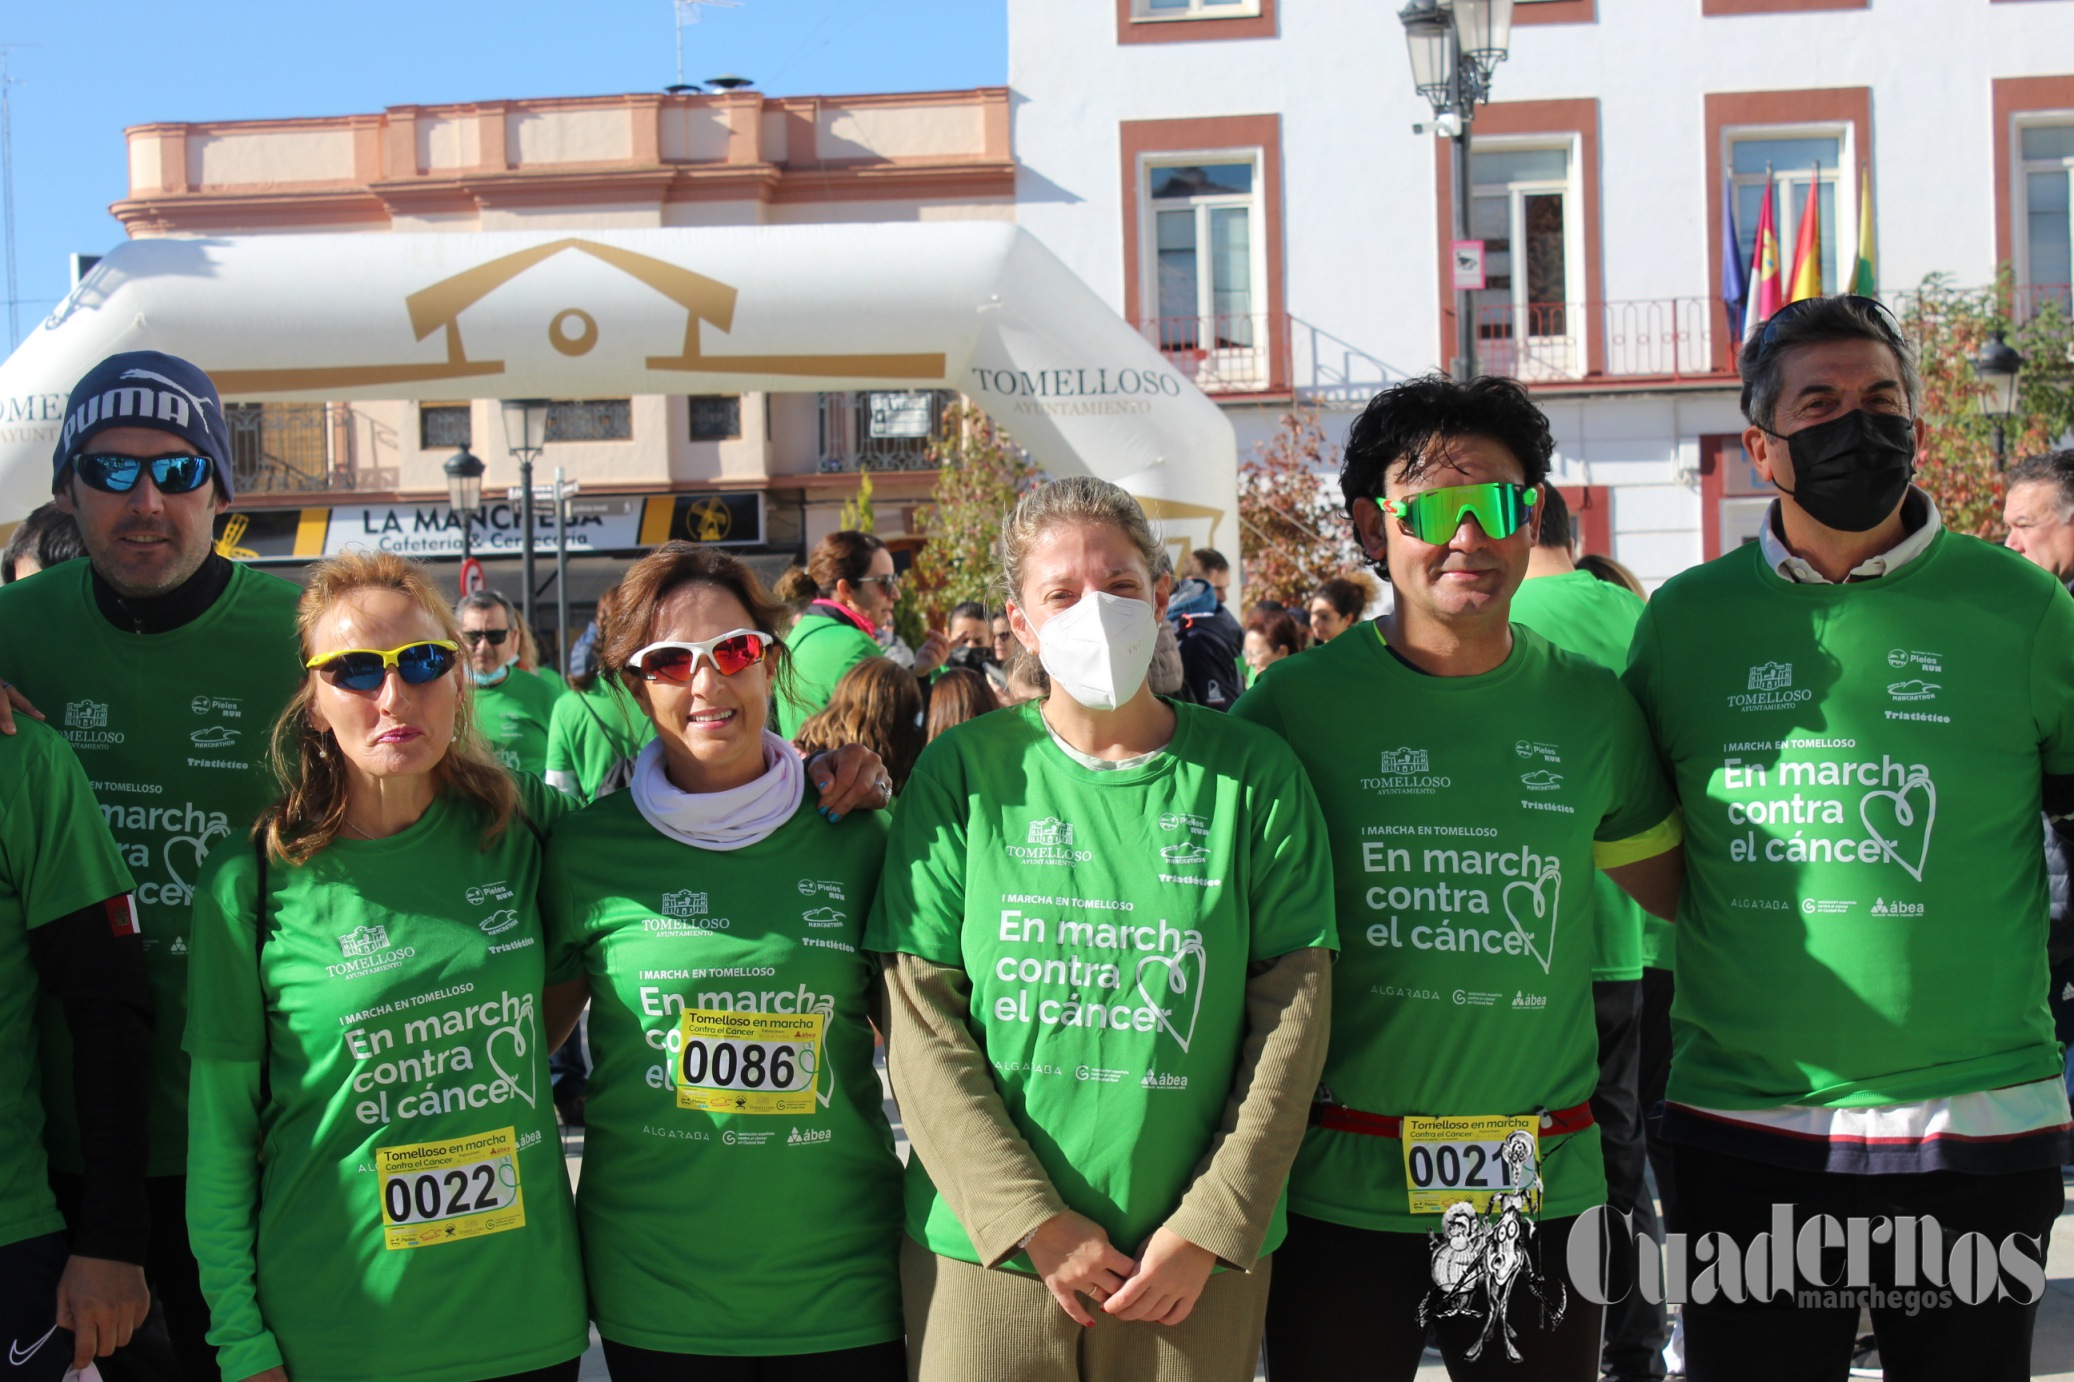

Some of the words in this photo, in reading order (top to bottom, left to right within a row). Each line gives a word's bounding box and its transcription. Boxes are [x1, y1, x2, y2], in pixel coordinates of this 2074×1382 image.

[972, 368, 1180, 397] TOMELLOSO
[0, 392, 70, 423] ME
[64, 387, 189, 452] PUMA
[1013, 400, 1152, 417] AYUNTAMIENTO
[363, 509, 402, 534] LA
[1727, 689, 1812, 707] TOMELLOSO
[1741, 702, 1796, 712] AYUNTAMIENTO
[1728, 740, 1772, 752] MARCHA
[1775, 739, 1789, 750] EN
[1791, 738, 1856, 749] TOMELLOSO
[188, 758, 248, 769] Triatlético
[1724, 758, 1766, 789] En
[1779, 754, 1929, 788] marcha
[105, 782, 162, 794] TOMELLOSO
[1360, 777, 1451, 789] TOMELLOSO
[1728, 793, 1844, 825] contra
[1367, 826, 1415, 835] MARCHA
[1417, 826, 1432, 835] EN
[1433, 826, 1498, 837] TOMELLOSO
[1006, 846, 1092, 862] TOMELLOSO
[1362, 842, 1411, 873] En
[1423, 845, 1560, 880] marcha
[1730, 831, 1757, 862] el
[1765, 830, 1898, 864] cáncer
[1021, 859, 1076, 867] AYUNTAMIENTO
[1007, 894, 1052, 904] MARCHA
[1056, 897, 1069, 906] EN
[1072, 898, 1133, 911] TOMELLOSO
[1366, 881, 1490, 915] contra
[641, 918, 730, 931] TOMELLOSO
[656, 930, 713, 938] AYUNTAMIENTO
[999, 910, 1045, 942] En
[1057, 919, 1203, 952] marcha
[1366, 915, 1403, 948] el
[1410, 919, 1535, 956] cáncer
[326, 947, 415, 978] TOMELLOSO
[345, 961, 402, 980] AYUNTAMIENTO
[644, 969, 689, 980] MARCHA
[692, 969, 707, 978] EN
[709, 967, 775, 978] TOMELLOSO
[996, 955, 1120, 989] contra
[346, 1004, 393, 1025] MARCHA
[394, 1000, 409, 1011] EN
[410, 983, 474, 1006] TOMELLOSO
[640, 987, 686, 1016] En
[698, 984, 835, 1015] marcha
[994, 990, 1030, 1022] el
[1038, 993, 1172, 1032] cáncer
[345, 1029, 394, 1060] En
[405, 990, 534, 1044] marcha
[689, 1013, 750, 1026] Tomelloso
[753, 1019, 767, 1027] en
[770, 1018, 813, 1028] marcha
[689, 1025, 716, 1033] Contra
[353, 1045, 474, 1093] contra
[645, 1059, 674, 1091] el
[683, 1040, 795, 1088] 0086
[356, 1091, 390, 1124] el
[397, 1074, 518, 1119] cáncer
[1410, 1131, 1436, 1139] Contra
[1411, 1120, 1469, 1130] Tomelloso
[1487, 1118, 1529, 1128] marcha
[384, 1146, 446, 1161] Tomelloso
[449, 1145, 463, 1154] en
[466, 1134, 506, 1151] marcha
[385, 1162, 414, 1171] Contra
[415, 1160, 423, 1168] el
[1409, 1144, 1511, 1188] 0021
[385, 1164, 499, 1223] 0022
